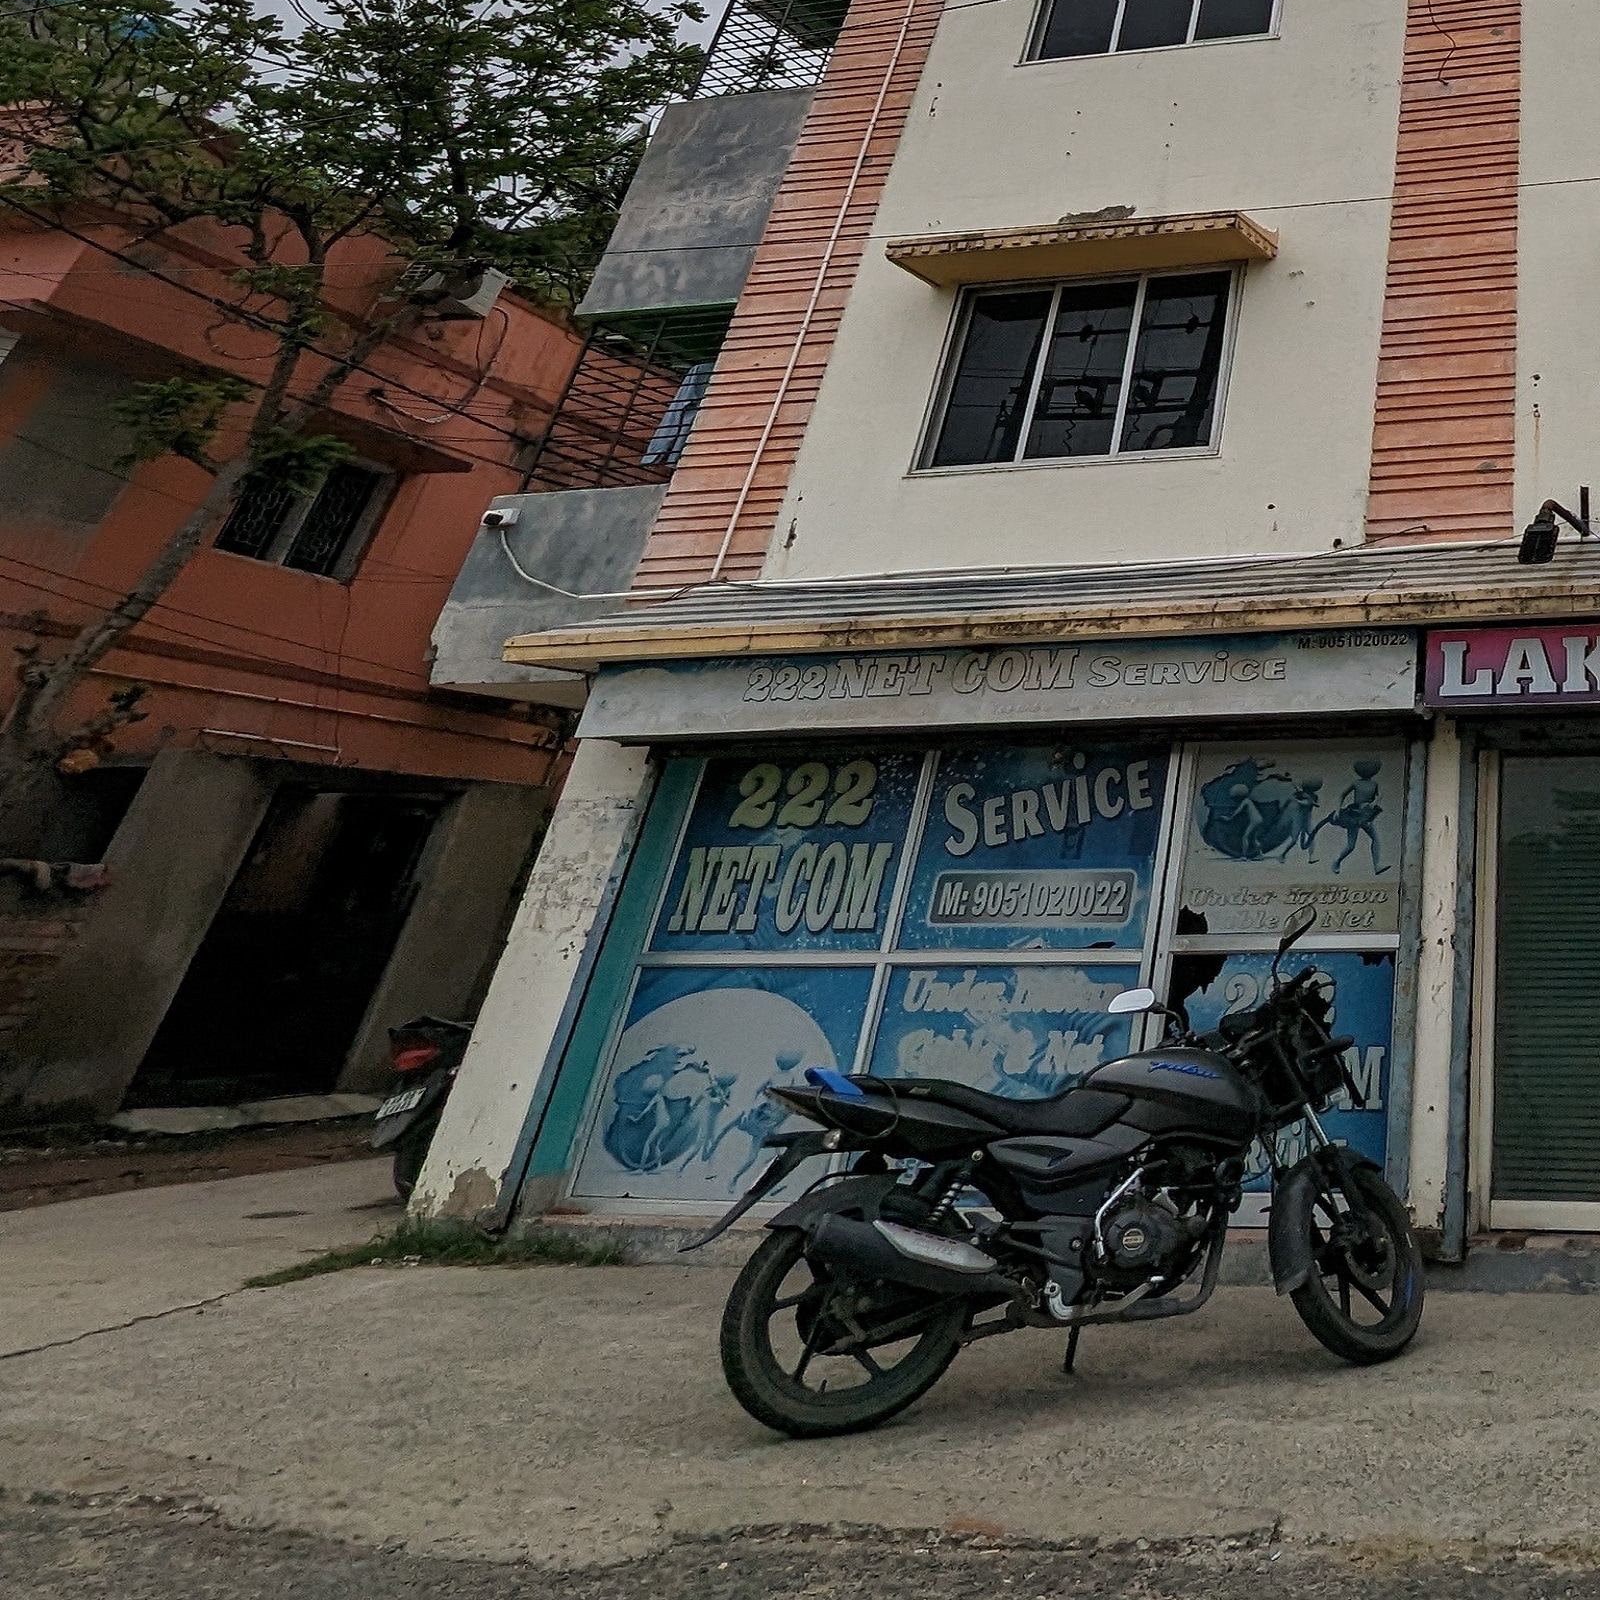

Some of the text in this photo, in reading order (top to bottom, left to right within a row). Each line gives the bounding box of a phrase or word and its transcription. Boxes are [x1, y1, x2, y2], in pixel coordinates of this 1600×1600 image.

[951, 648, 1080, 694] COM
[728, 758, 877, 829] 222
[667, 841, 893, 933] NET COM
[971, 880, 1128, 917] 9051020022
[1188, 887, 1278, 907] Under
[1322, 909, 1376, 929] Net
